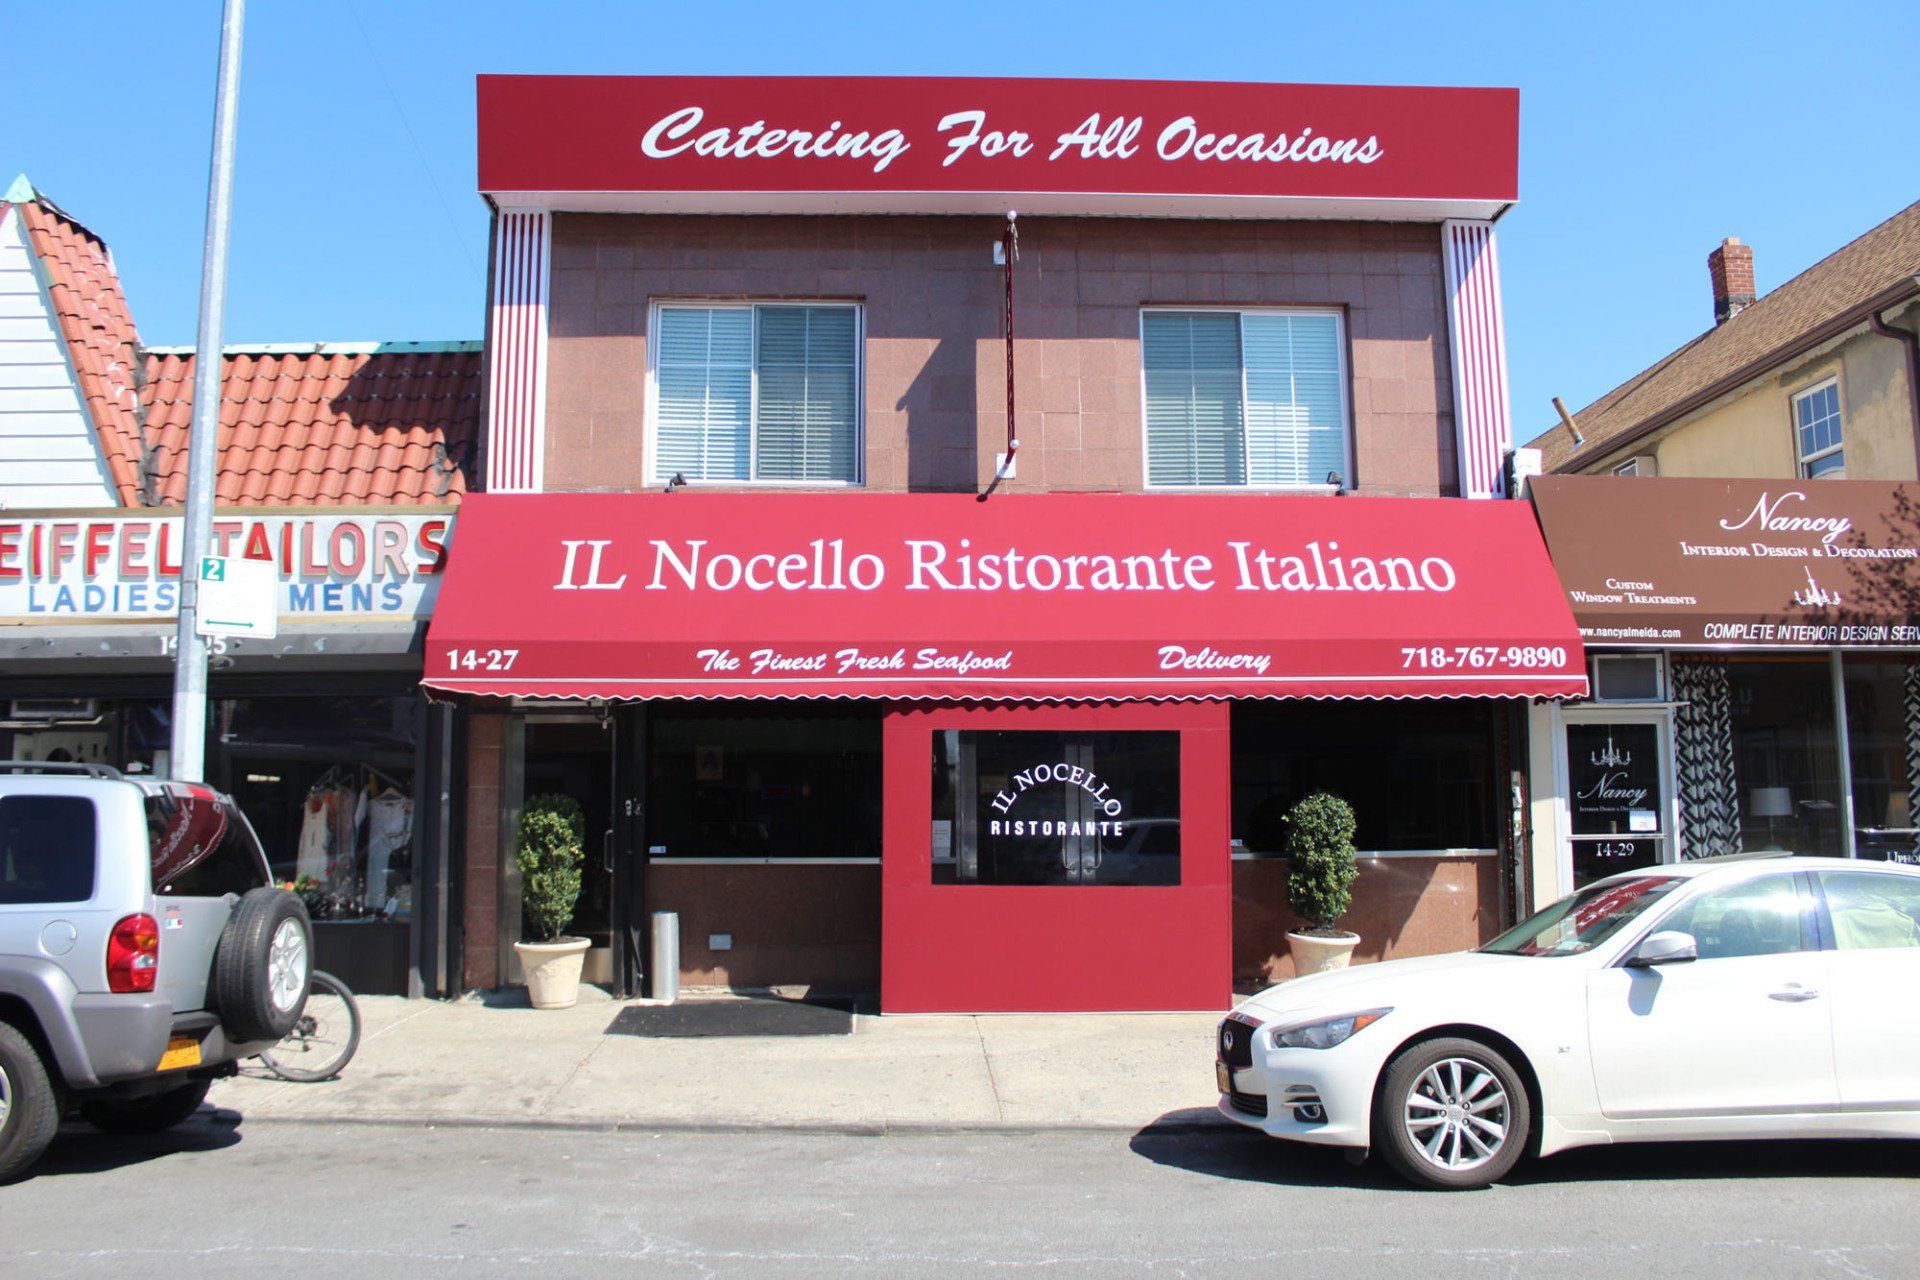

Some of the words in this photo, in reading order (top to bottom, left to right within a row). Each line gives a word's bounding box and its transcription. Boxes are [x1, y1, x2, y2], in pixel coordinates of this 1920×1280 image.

[640, 106, 911, 173] Catering
[937, 110, 1034, 167] For
[1048, 112, 1143, 161] All
[1156, 116, 1384, 164] Occasions
[1719, 491, 1851, 544] Nancy
[211, 521, 448, 576] TAILORS
[1812, 547, 1823, 557] &
[206, 559, 220, 580] 2
[553, 540, 627, 590] IL
[644, 538, 885, 591] Nocello
[904, 538, 1215, 592] Ristorante
[1227, 541, 1456, 592] Italiano
[29, 583, 175, 612] LADIES
[289, 582, 402, 611] MENS
[1577, 627, 1681, 639] ww.nancyalmeida.com
[1704, 623, 1775, 640] COMPLETE
[1777, 625, 1837, 641] INTERIOR
[1840, 625, 1888, 641] DESIGN
[446, 649, 519, 671] 14-27
[696, 648, 740, 672] The
[749, 648, 827, 675] Finest
[834, 648, 906, 674] Fresh
[912, 648, 1013, 675] Seafood
[1158, 646, 1271, 674] Delivery
[1401, 646, 1567, 668] 718-767-9890
[991, 790, 1017, 814] IL
[1013, 763, 1122, 817] NOCELLO
[1576, 771, 1648, 807] Nancy
[991, 820, 1123, 837] RISTORANTE
[1596, 842, 1635, 857] 14-29
